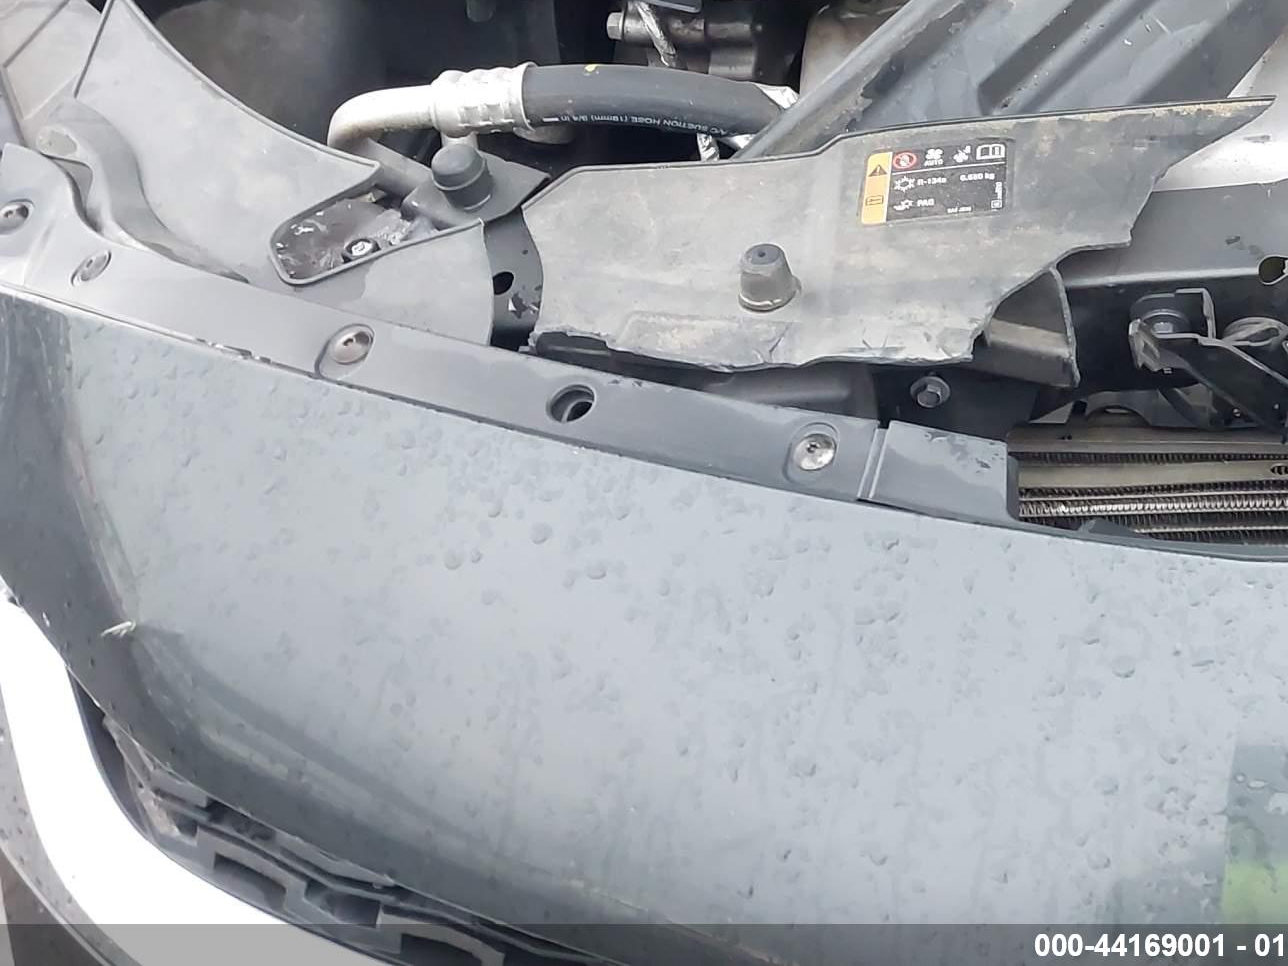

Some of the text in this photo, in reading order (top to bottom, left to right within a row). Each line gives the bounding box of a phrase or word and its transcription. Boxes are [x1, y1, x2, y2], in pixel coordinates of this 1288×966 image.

[631, 115, 660, 125] HOSE
[924, 158, 944, 167] AUTO
[917, 177, 947, 186] R-134a
[917, 198, 935, 207] PAG
